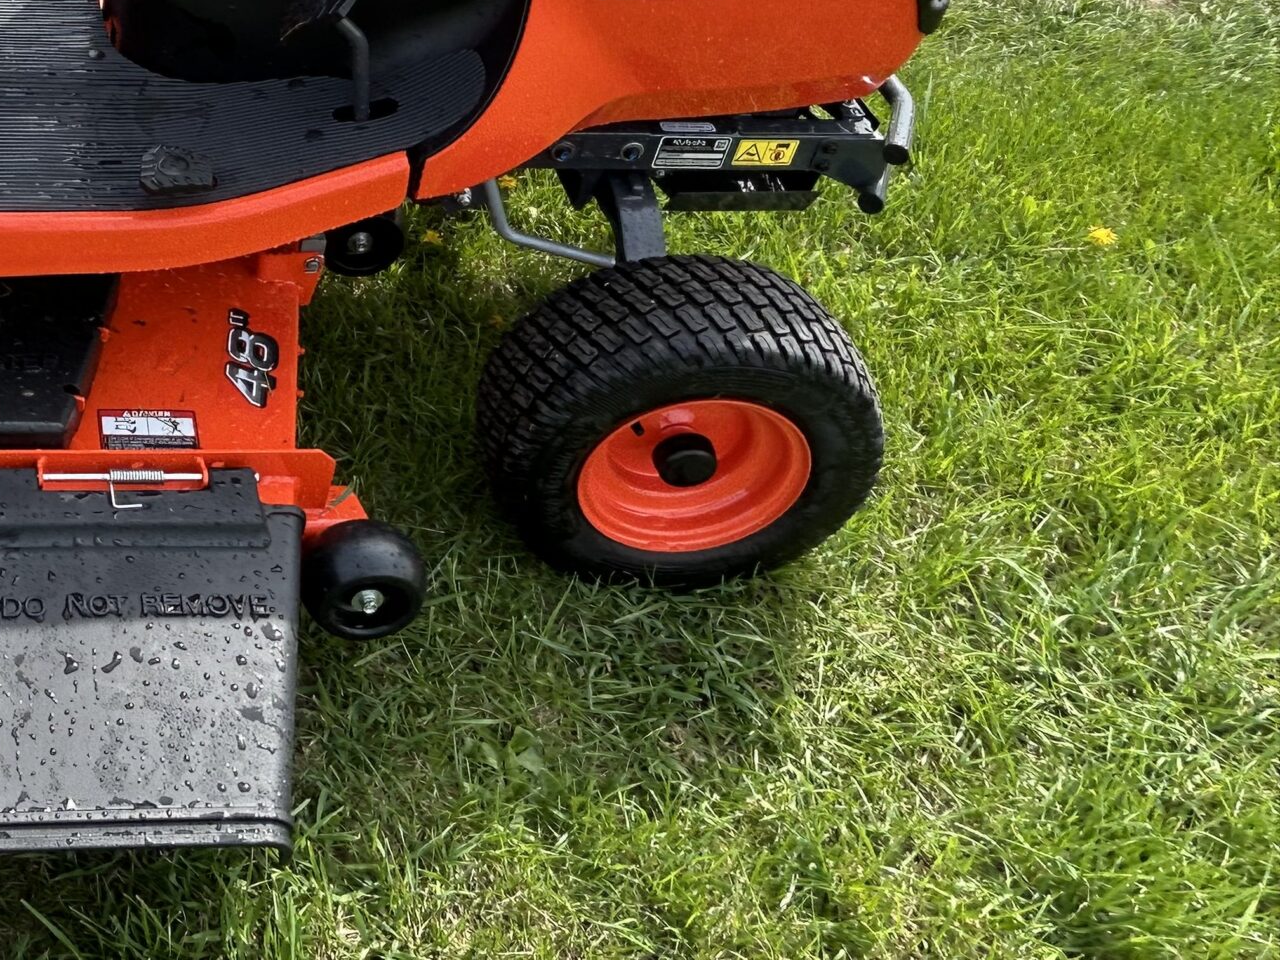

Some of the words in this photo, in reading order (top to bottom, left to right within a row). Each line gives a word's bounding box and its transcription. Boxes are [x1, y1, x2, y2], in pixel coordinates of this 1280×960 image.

[0, 595, 46, 620] DO
[65, 593, 129, 618] NOT
[140, 592, 271, 619] REMOVE
